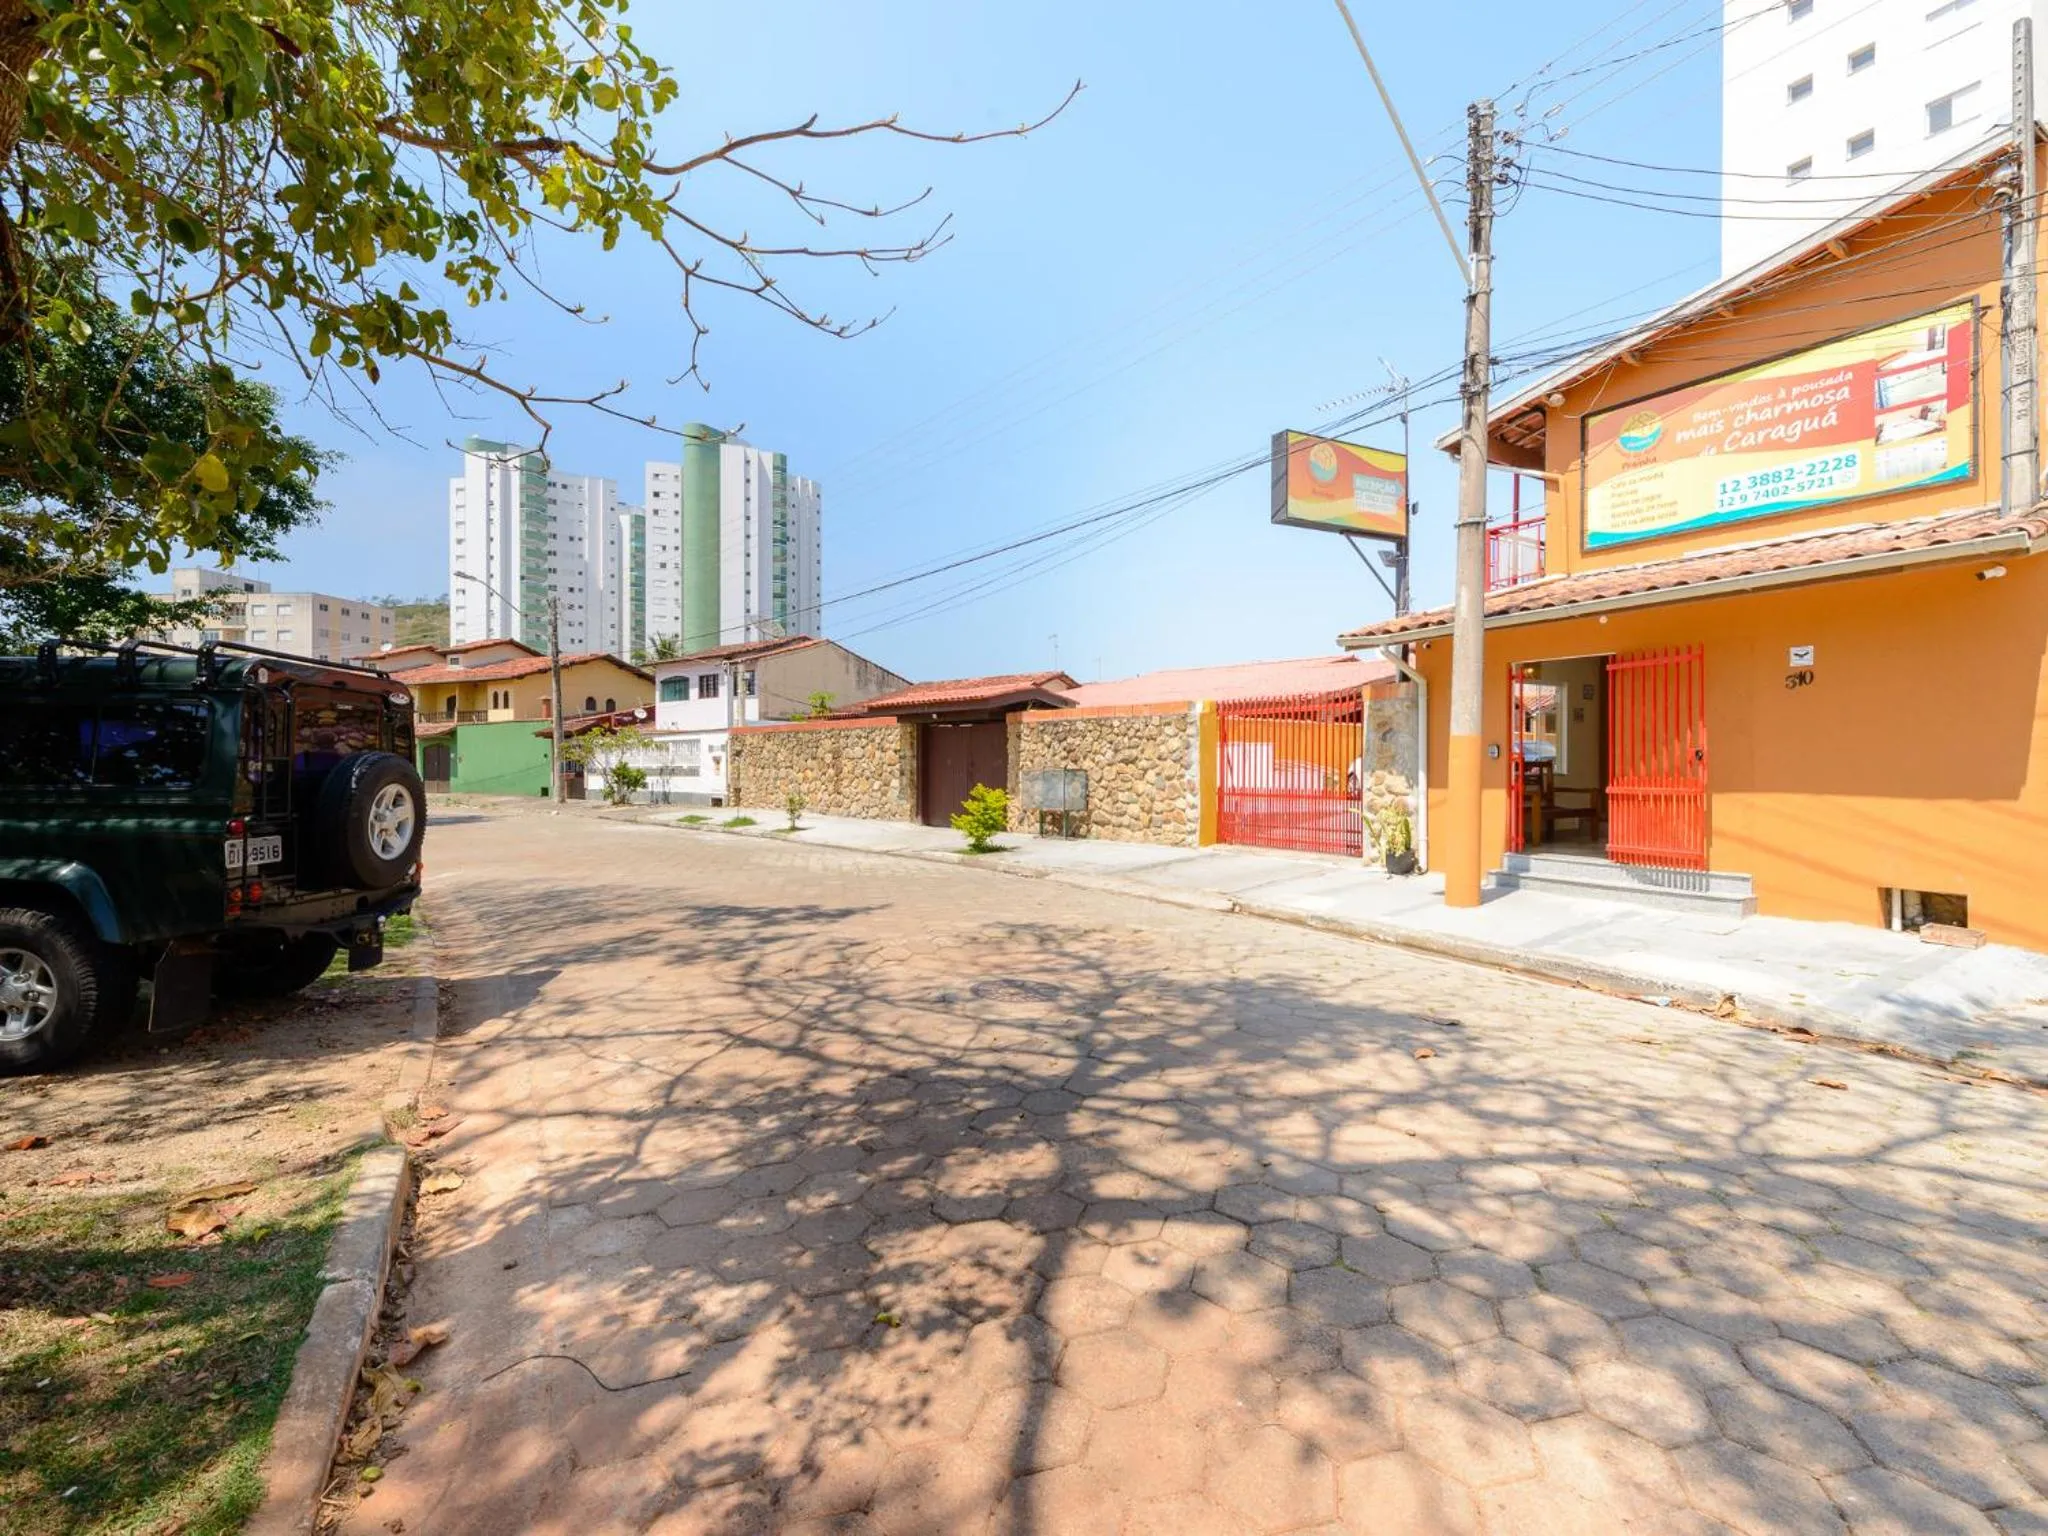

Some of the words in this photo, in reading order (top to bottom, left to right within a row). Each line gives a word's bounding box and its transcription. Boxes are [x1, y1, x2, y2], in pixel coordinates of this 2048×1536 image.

[1675, 417, 1725, 444] mais
[1733, 385, 1851, 429] charmosa
[1692, 393, 1773, 424] Bem-vindos
[1791, 370, 1854, 398] pousada
[1699, 444, 1718, 457] de
[1723, 404, 1839, 451] Caraguá
[1719, 480, 1742, 495] 12
[1747, 453, 1857, 490] 3882-2228
[1753, 475, 1835, 501] 7402-5721
[1785, 669, 1814, 690] 310
